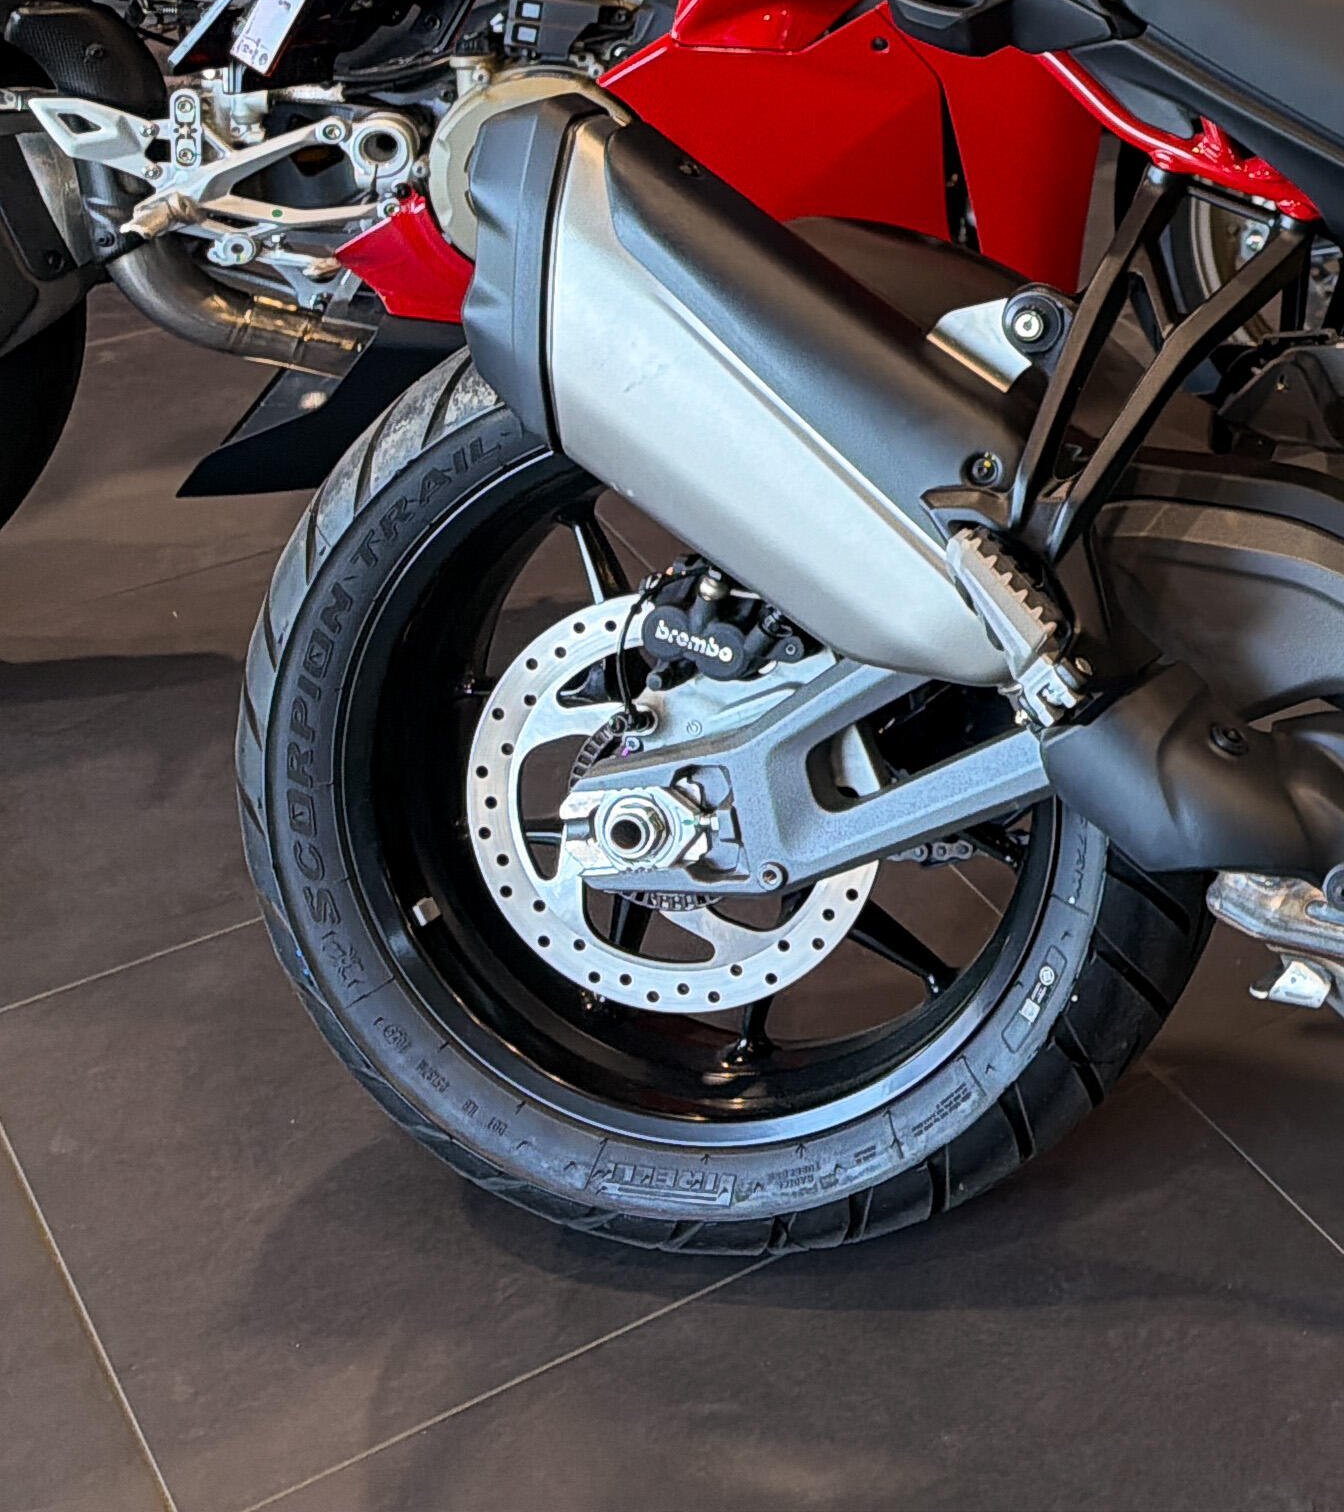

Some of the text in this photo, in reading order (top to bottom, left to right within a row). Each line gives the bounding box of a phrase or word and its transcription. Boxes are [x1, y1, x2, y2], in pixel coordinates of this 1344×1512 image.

[286, 433, 503, 926] SCORPION TRAIL
[654, 619, 734, 663] brembo
